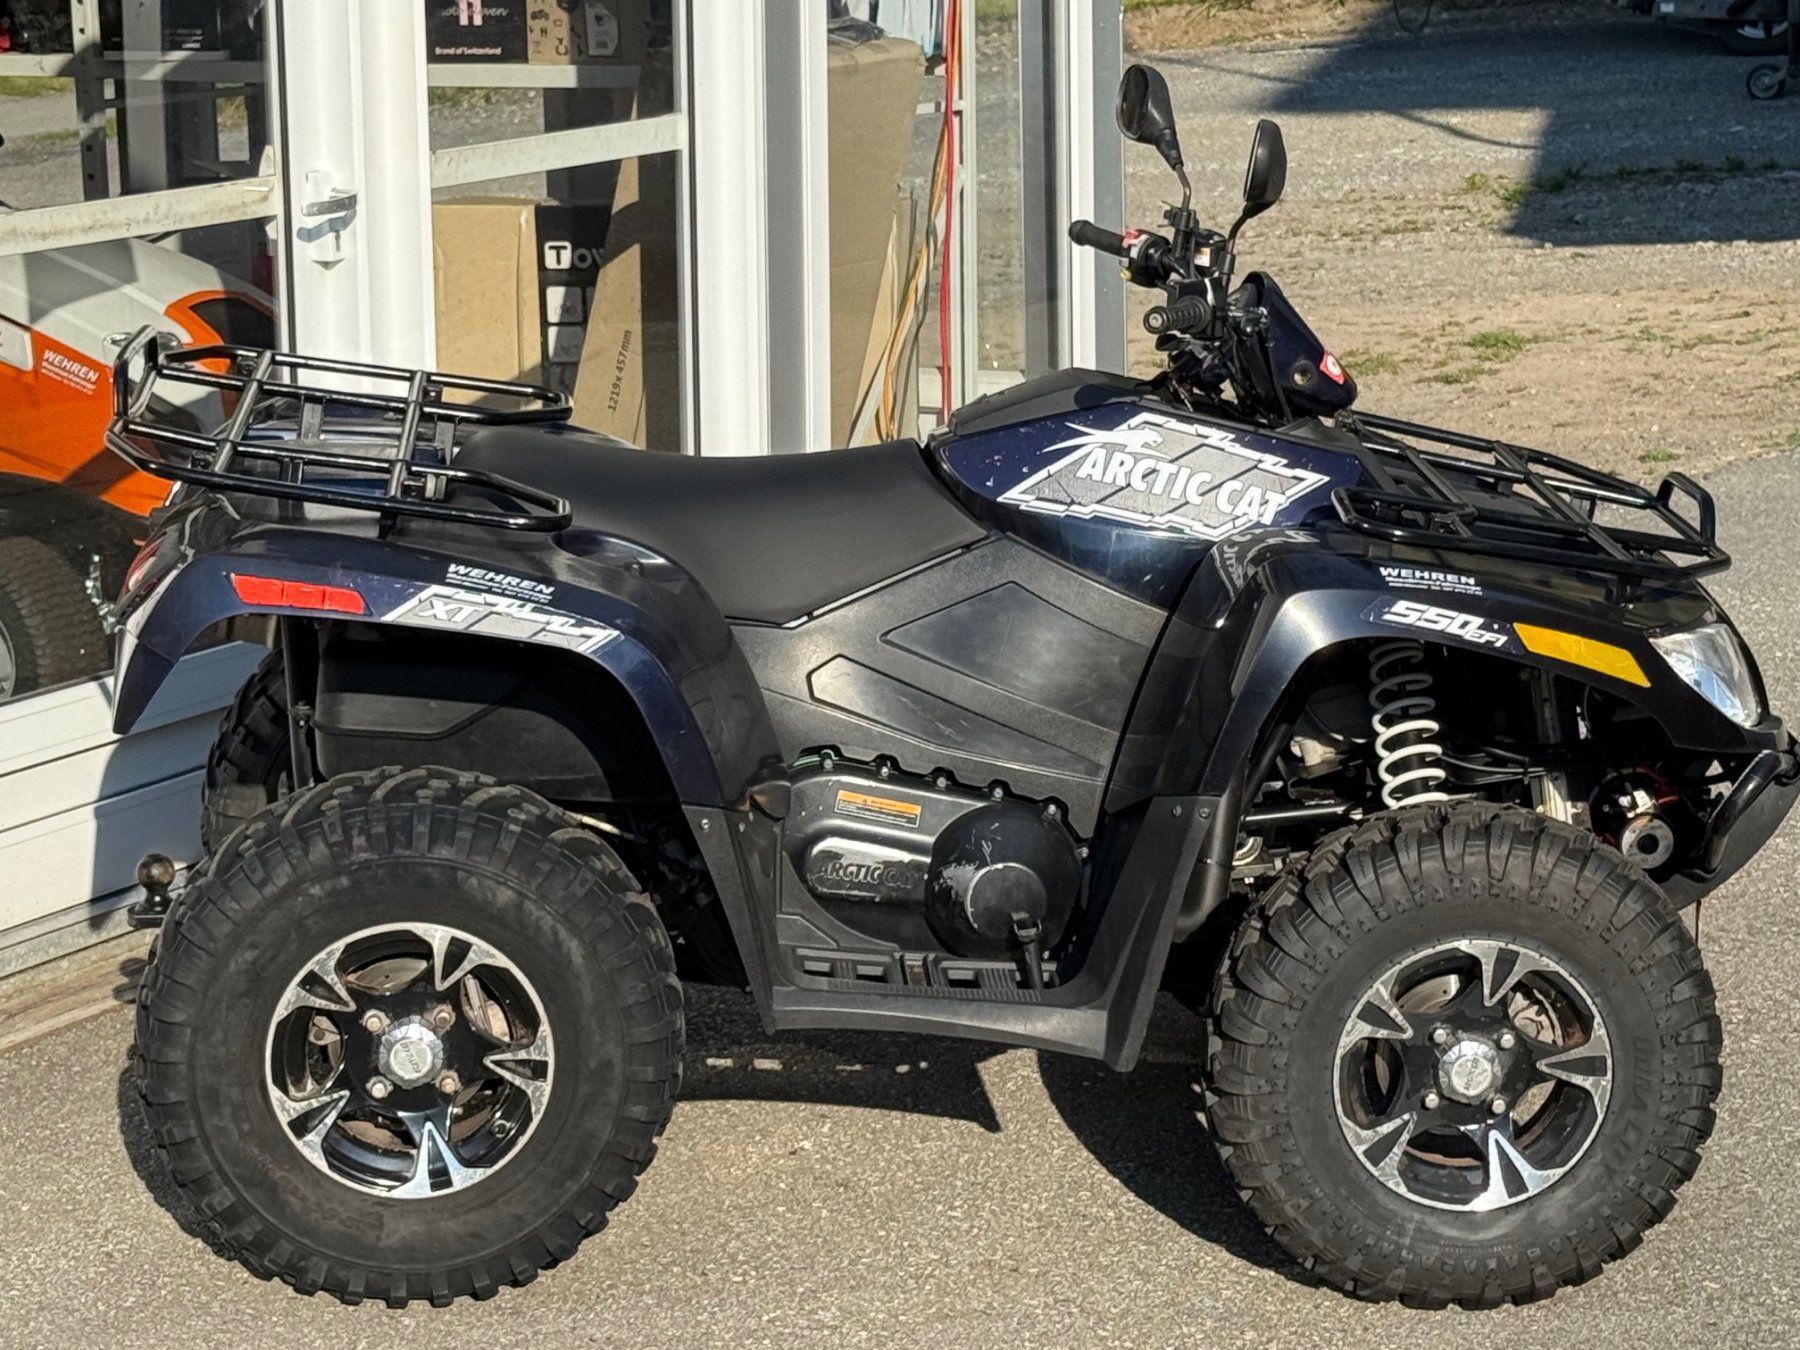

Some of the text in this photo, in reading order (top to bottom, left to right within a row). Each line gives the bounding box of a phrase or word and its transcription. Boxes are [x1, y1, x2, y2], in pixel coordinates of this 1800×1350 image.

[43, 349, 100, 382] WEHREN
[1076, 448, 1287, 526] ARCTIC CAT
[447, 563, 556, 595] WEHREN
[1379, 566, 1475, 585] WEHREN
[417, 599, 486, 623] XT
[818, 860, 884, 885] ARCTIC
